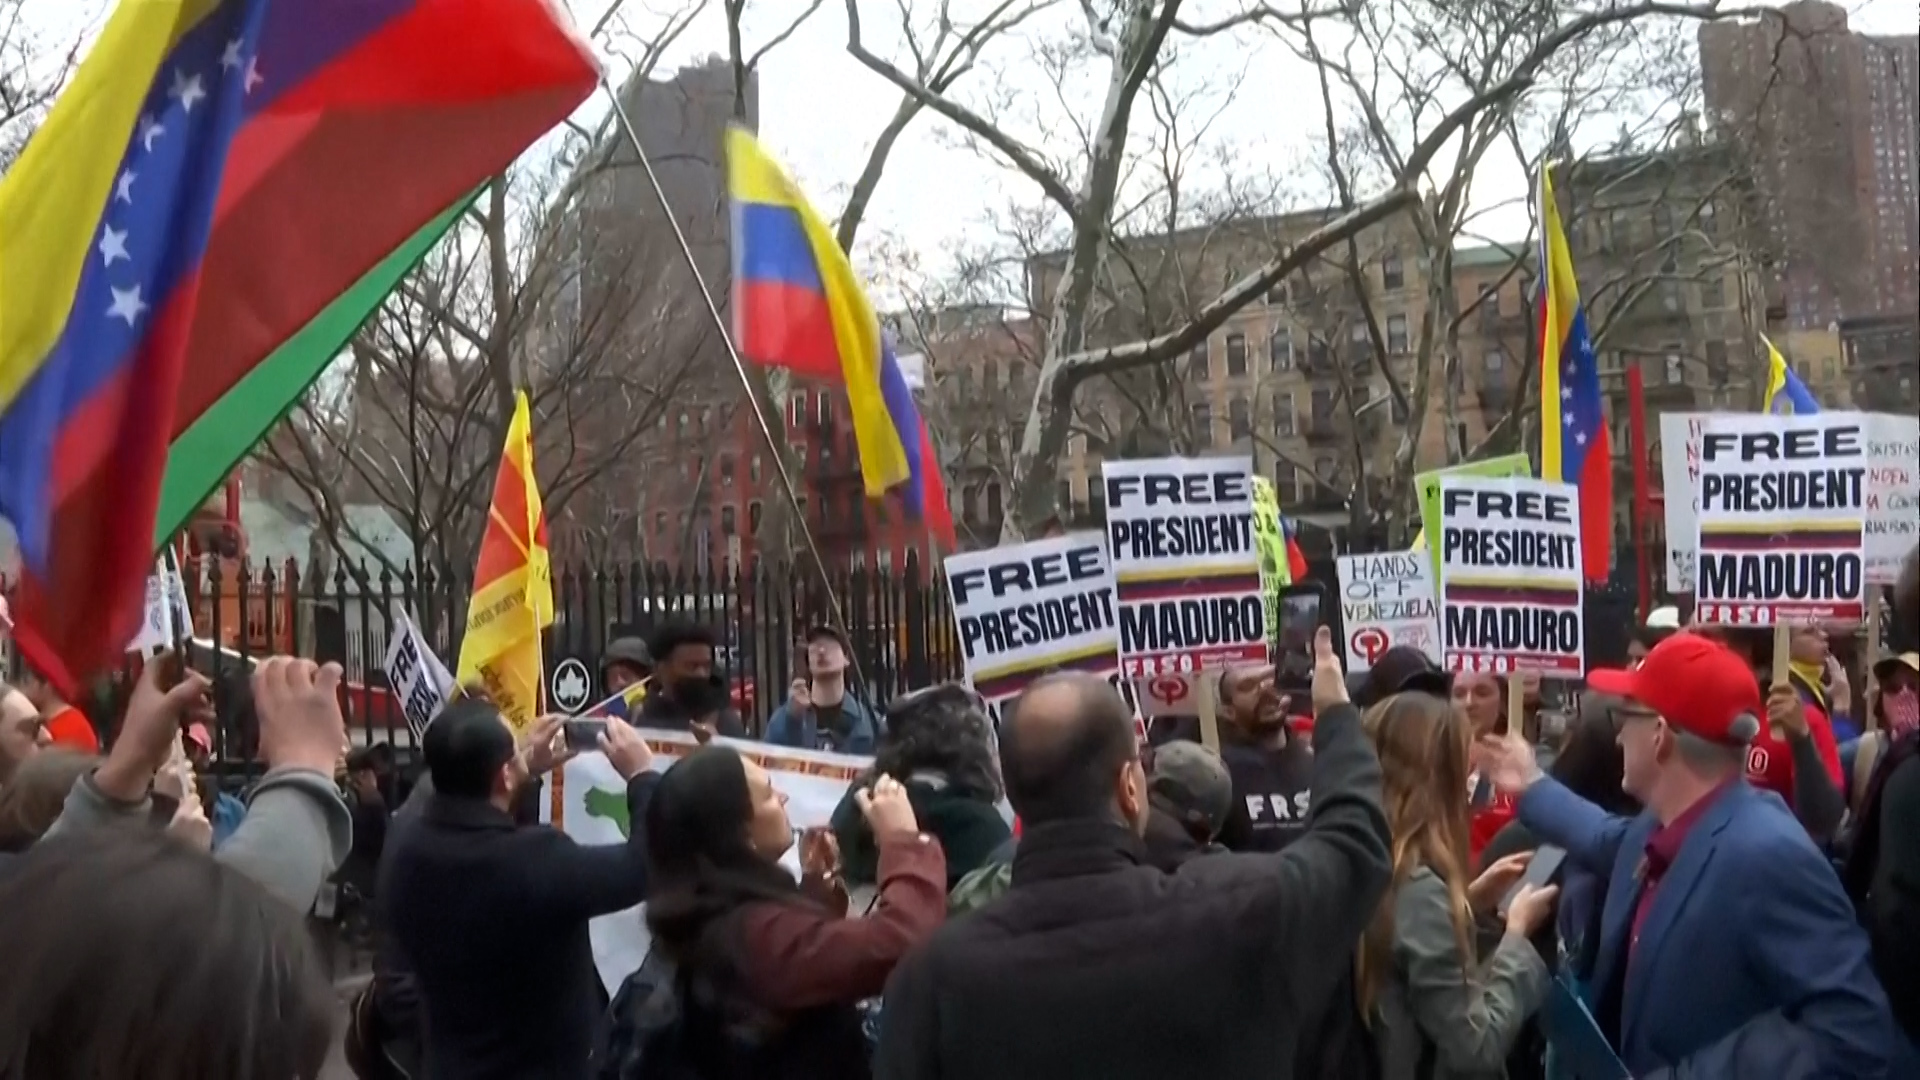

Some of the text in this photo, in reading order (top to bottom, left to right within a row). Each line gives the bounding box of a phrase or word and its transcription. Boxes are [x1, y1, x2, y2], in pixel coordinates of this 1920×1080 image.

[1703, 425, 1862, 462] FREE
[1107, 471, 1248, 508] FREE
[1444, 489, 1572, 524] FREE
[1702, 467, 1865, 512] PRESIDENT
[1111, 513, 1252, 560] PRESIDENT
[1445, 528, 1576, 569] PRESIDENT
[950, 545, 1105, 606] FREE
[1351, 554, 1419, 580] HANDS
[1700, 553, 1861, 601] MADURO
[1344, 598, 1436, 621] VENEZUELA
[1346, 580, 1412, 600] OFF
[960, 588, 1115, 658] PRESIDENT
[1119, 596, 1265, 654] MADURO
[1446, 606, 1578, 653] MADURO
[1126, 654, 1193, 678] FRSO
[1245, 788, 1311, 820] FRS
